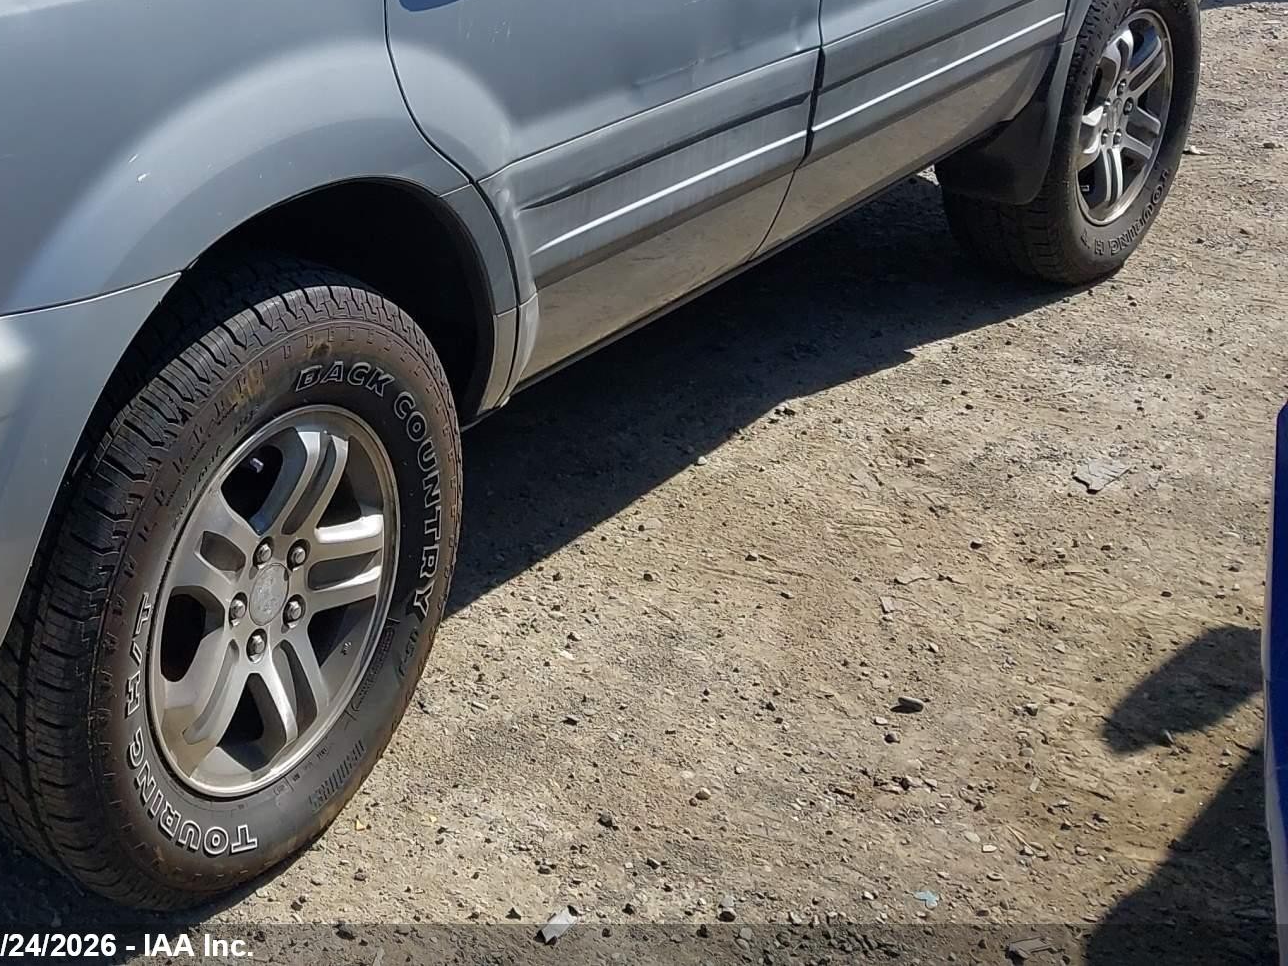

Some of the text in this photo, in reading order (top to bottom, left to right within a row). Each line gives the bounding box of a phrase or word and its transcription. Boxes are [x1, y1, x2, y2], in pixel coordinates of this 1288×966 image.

[295, 361, 443, 621] BACK COUNTRY
[125, 591, 259, 856] TOURING H/T
